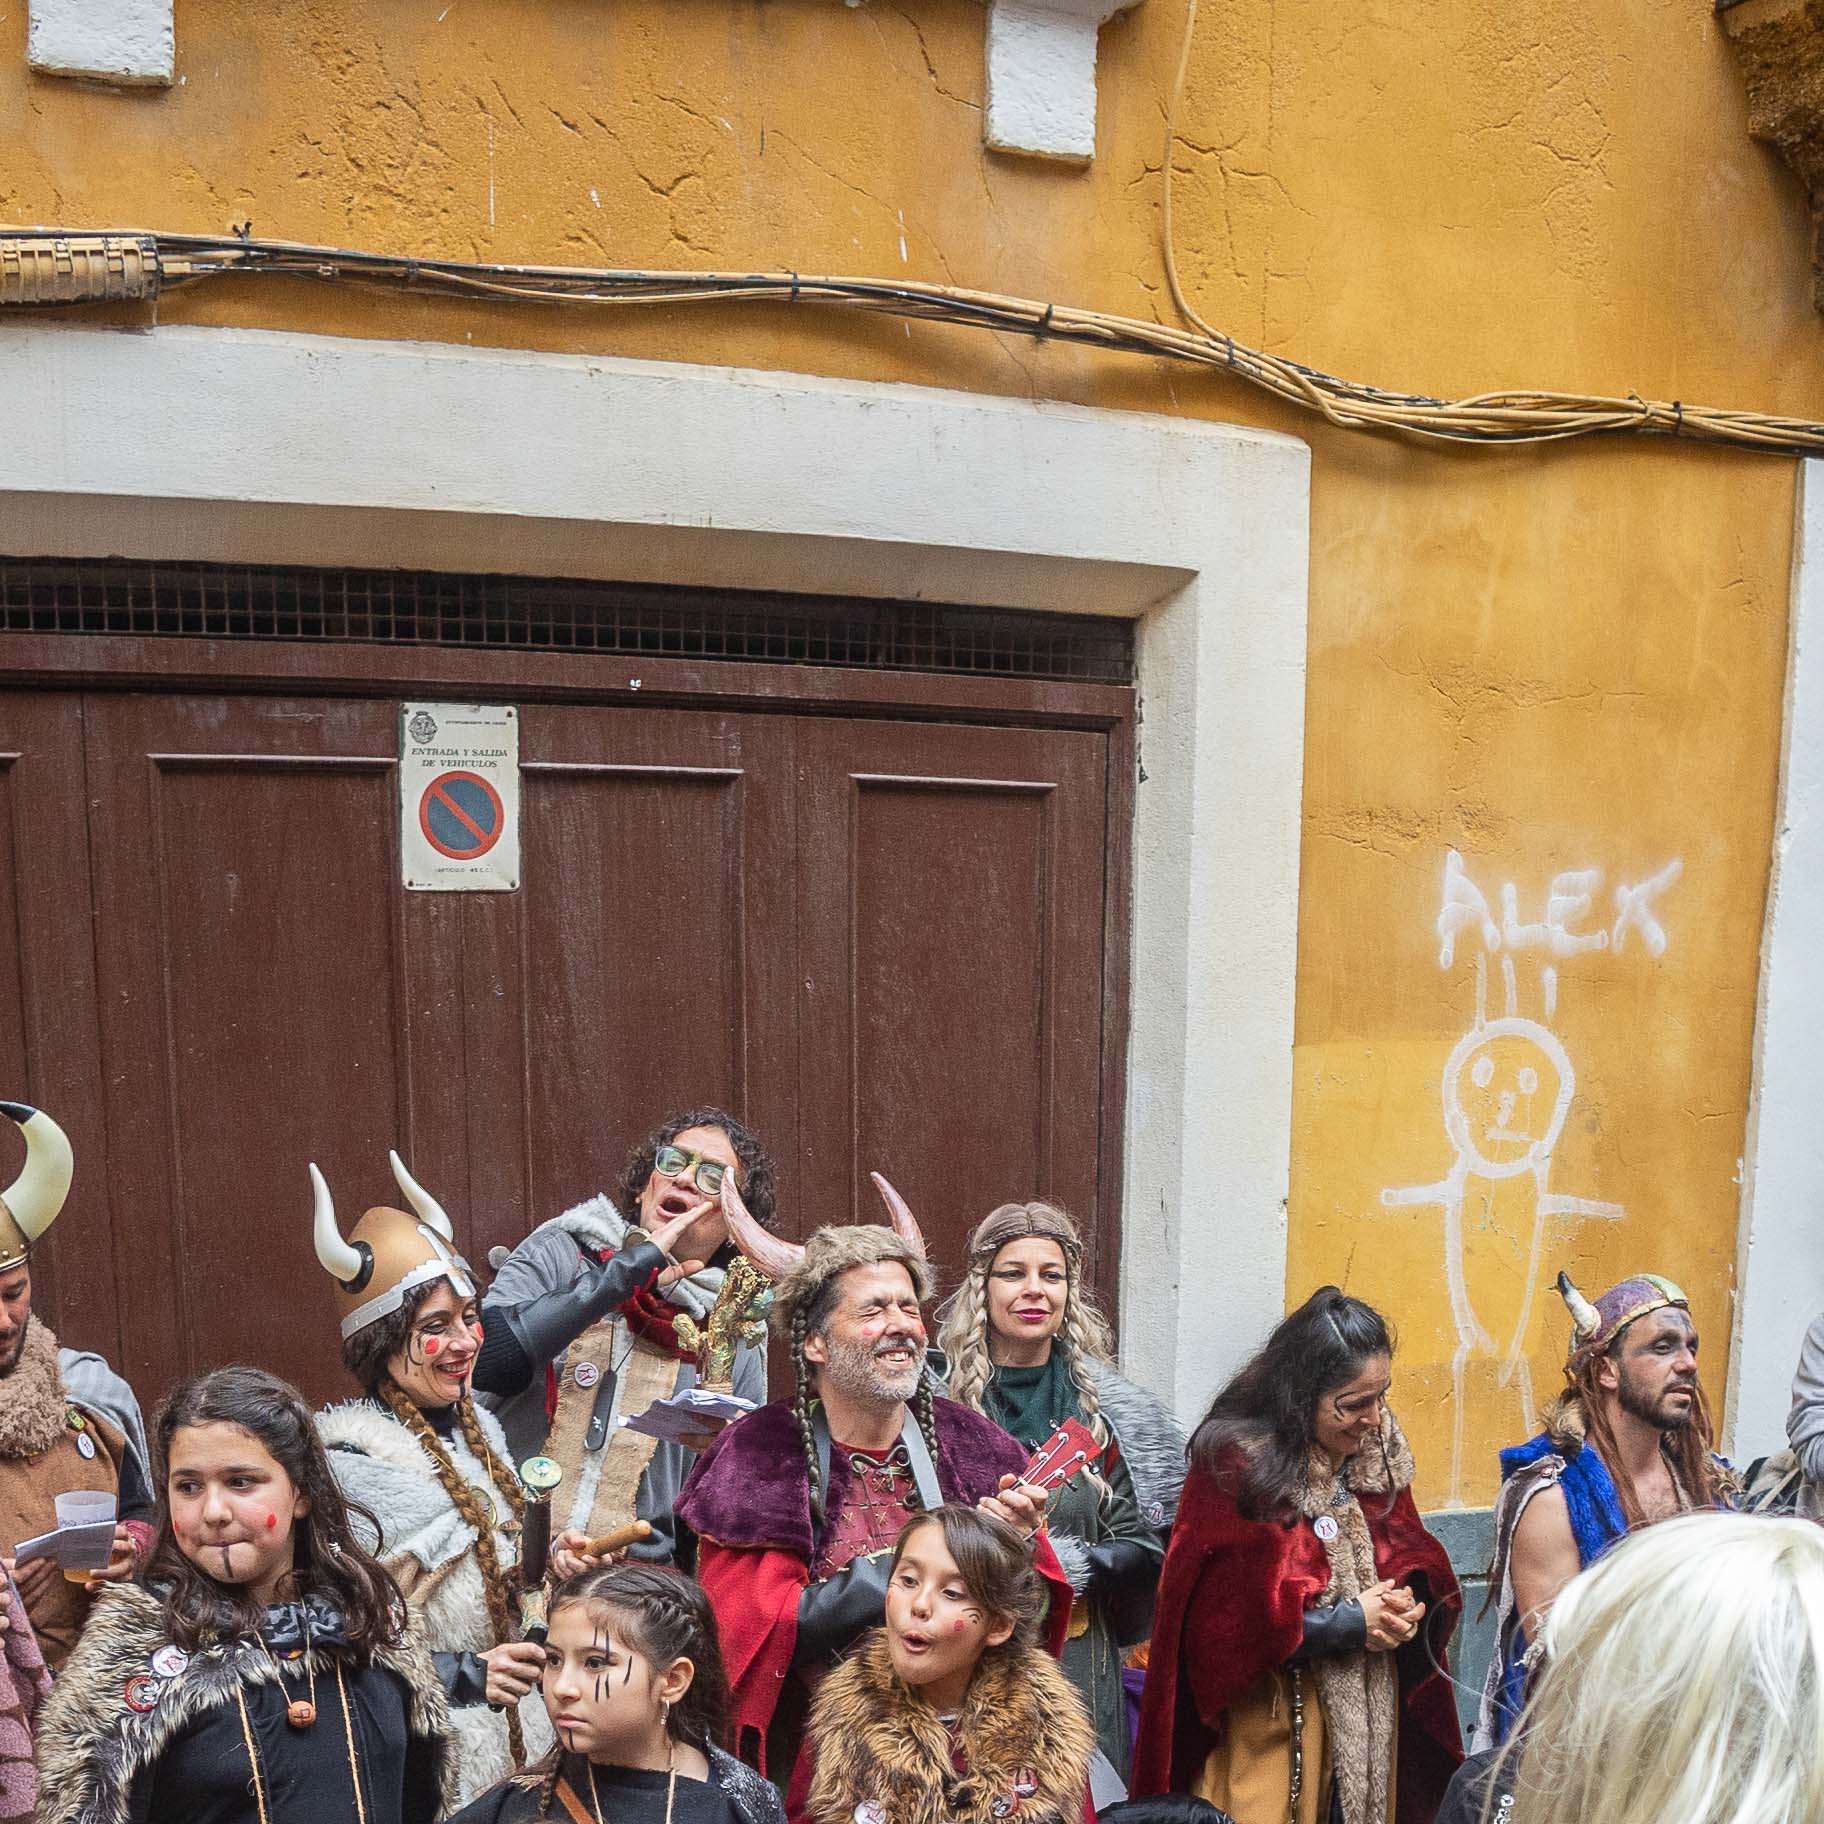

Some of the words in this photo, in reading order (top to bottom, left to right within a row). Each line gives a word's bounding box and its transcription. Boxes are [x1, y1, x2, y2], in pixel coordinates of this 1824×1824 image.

[411, 748, 459, 756] ENTRADA
[471, 749, 508, 757] SALIDA
[422, 759, 436, 767] DE
[440, 759, 498, 768] VEHICULOS
